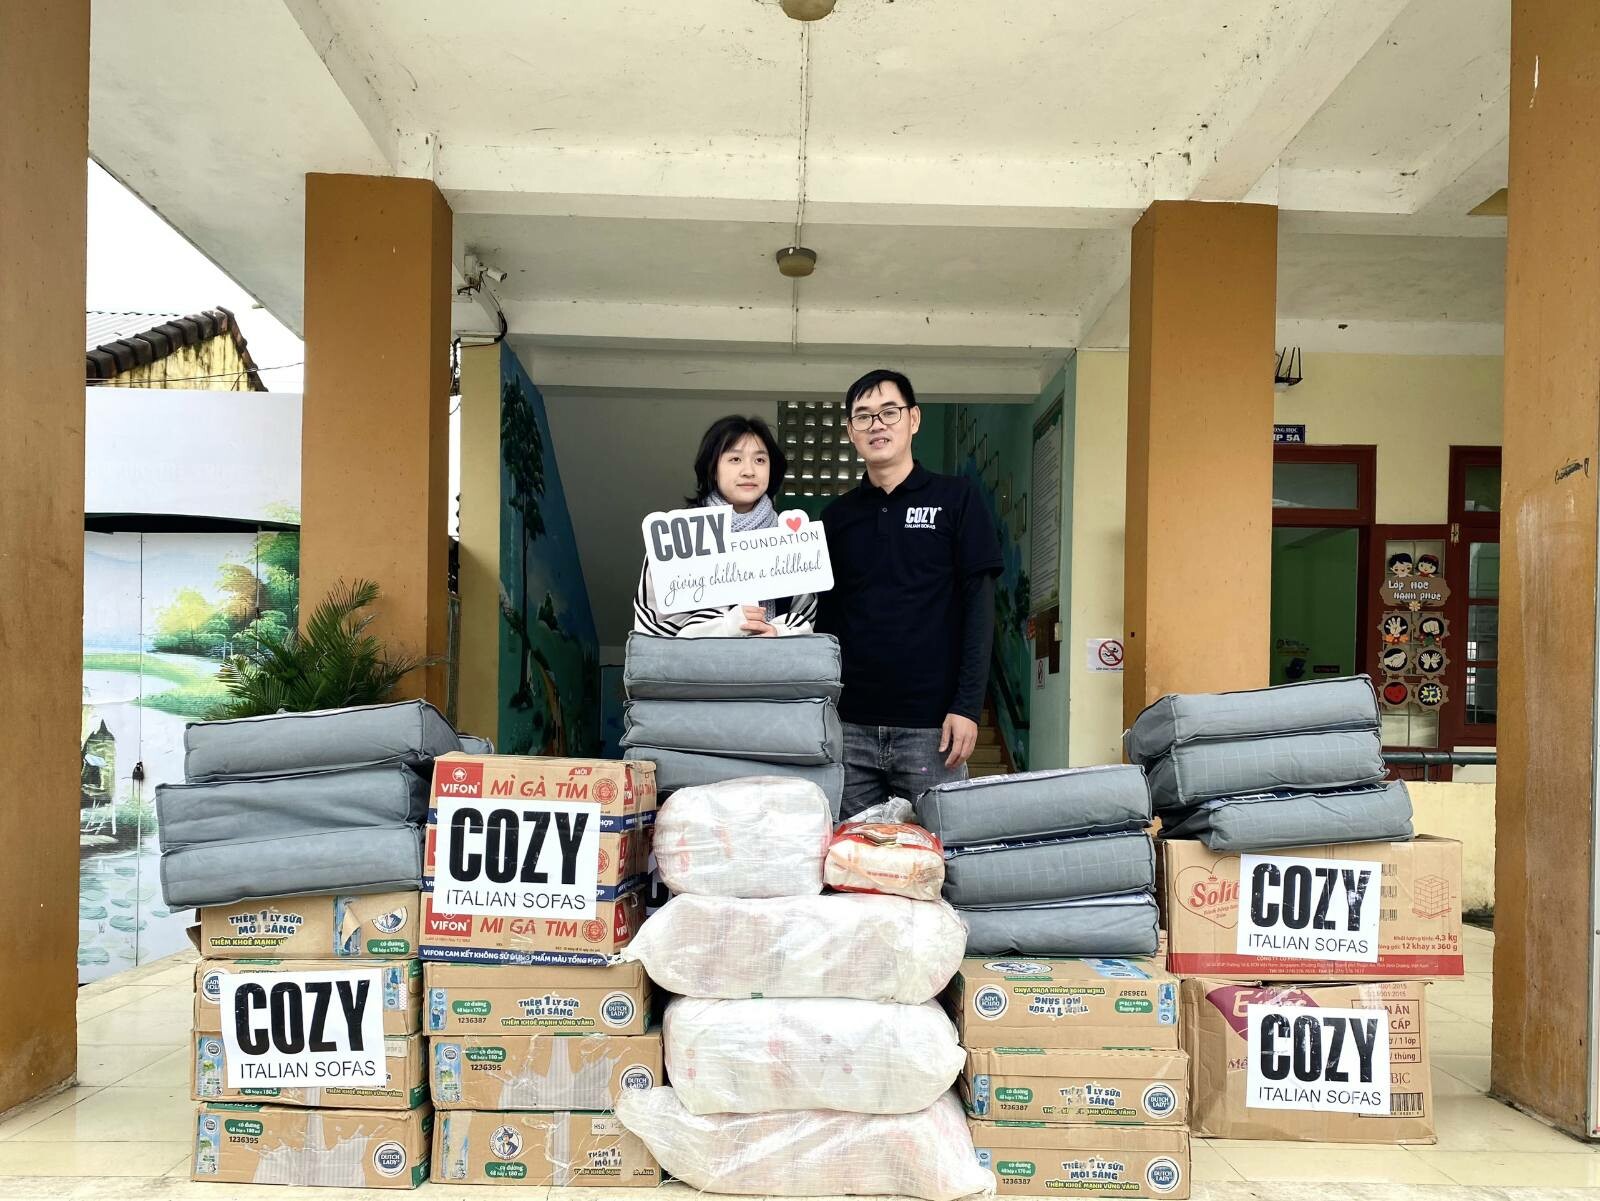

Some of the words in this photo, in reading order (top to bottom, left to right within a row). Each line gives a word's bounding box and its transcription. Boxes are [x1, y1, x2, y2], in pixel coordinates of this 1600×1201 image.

[905, 506, 938, 524] COZY
[650, 513, 727, 562] COZY
[731, 531, 820, 552] FOUNDATION
[665, 573, 705, 606] giving
[709, 562, 755, 586] children
[759, 572, 767, 580] a
[770, 550, 822, 577] childhood
[441, 783, 479, 795] VIFON
[490, 774, 516, 796] MÌ
[520, 775, 547, 798] GÀ
[556, 776, 589, 800] TÍM
[448, 807, 590, 885] COZY
[446, 890, 517, 907] ITALIAN
[522, 893, 587, 910] SOFAS
[1189, 880, 1240, 908] Solit
[1250, 863, 1372, 932] COZY
[260, 910, 268, 921] 1
[269, 914, 282, 923] LY
[283, 914, 303, 925] SỮA
[431, 920, 468, 932] VIFON
[211, 938, 231, 946] THÊM
[1248, 933, 1309, 951] ITALIAN
[1314, 937, 1369, 954] SOFAS
[1448, 933, 1458, 943] kg
[1411, 943, 1430, 951] khay
[423, 949, 444, 958] VIFON
[445, 950, 460, 959] CAM
[461, 949, 474, 959] KẾT
[474, 950, 499, 961] KHÔNG
[551, 953, 567, 963] MÀU
[519, 998, 542, 1008] THÊM
[545, 996, 550, 1006] 1
[552, 999, 562, 1007] LY
[1394, 1003, 1410, 1014] ĂN
[235, 979, 371, 1056] COZY
[547, 1006, 573, 1017] SÁNG
[1260, 1013, 1379, 1083] COZY
[241, 1061, 309, 1080] ITALIAN
[315, 1059, 376, 1078] SOFAS
[1391, 1072, 1411, 1085] BJC
[1085, 1085, 1091, 1095] 1
[1104, 1088, 1121, 1098] SỮA
[1259, 1085, 1321, 1104] ITALIAN
[1326, 1089, 1382, 1106] SOFAS
[1088, 1095, 1115, 1106] SÁNG
[228, 1135, 259, 1144] 1236395
[1091, 1169, 1117, 1180] SÁNG
